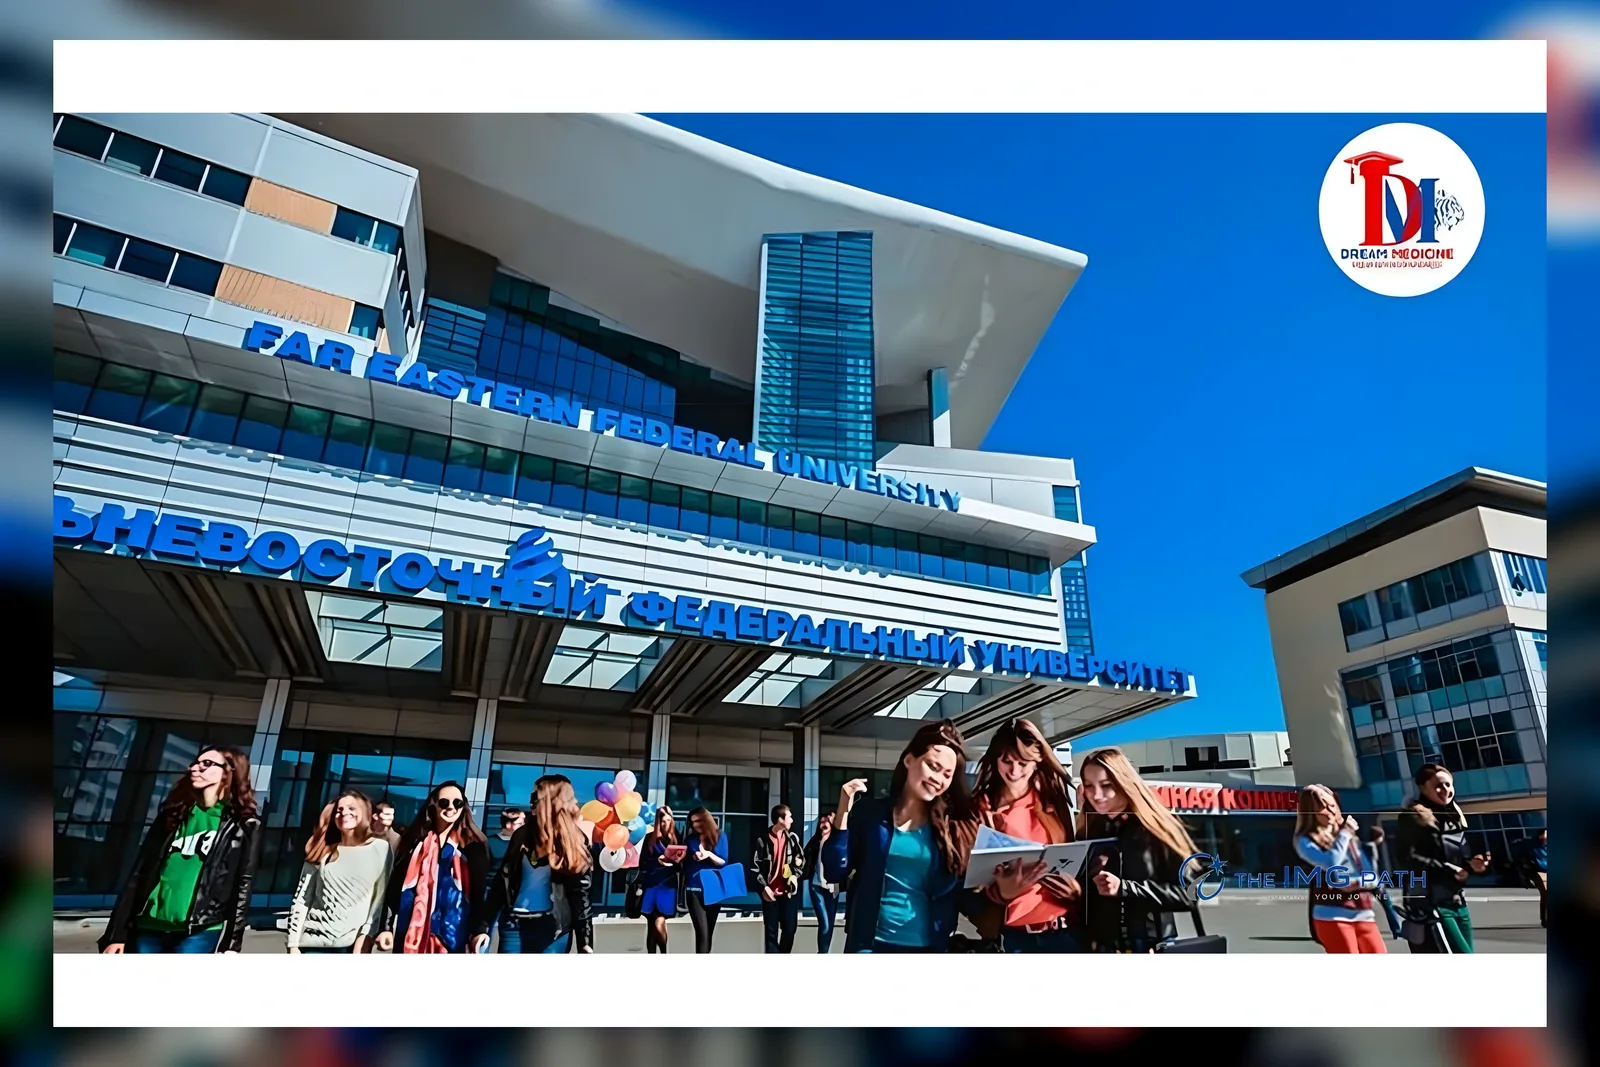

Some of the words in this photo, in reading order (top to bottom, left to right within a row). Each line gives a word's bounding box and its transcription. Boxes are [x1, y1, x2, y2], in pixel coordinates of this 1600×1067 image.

[244, 319, 357, 376] FAR
[363, 351, 583, 428] EASTERN
[594, 407, 766, 469] FEDERAL
[773, 447, 963, 513] UNIVERSITY
[628, 589, 967, 670] ФЕДЕРАЛЬНЫЙ
[974, 639, 1194, 694] УНИВЕРСИТЕТ
